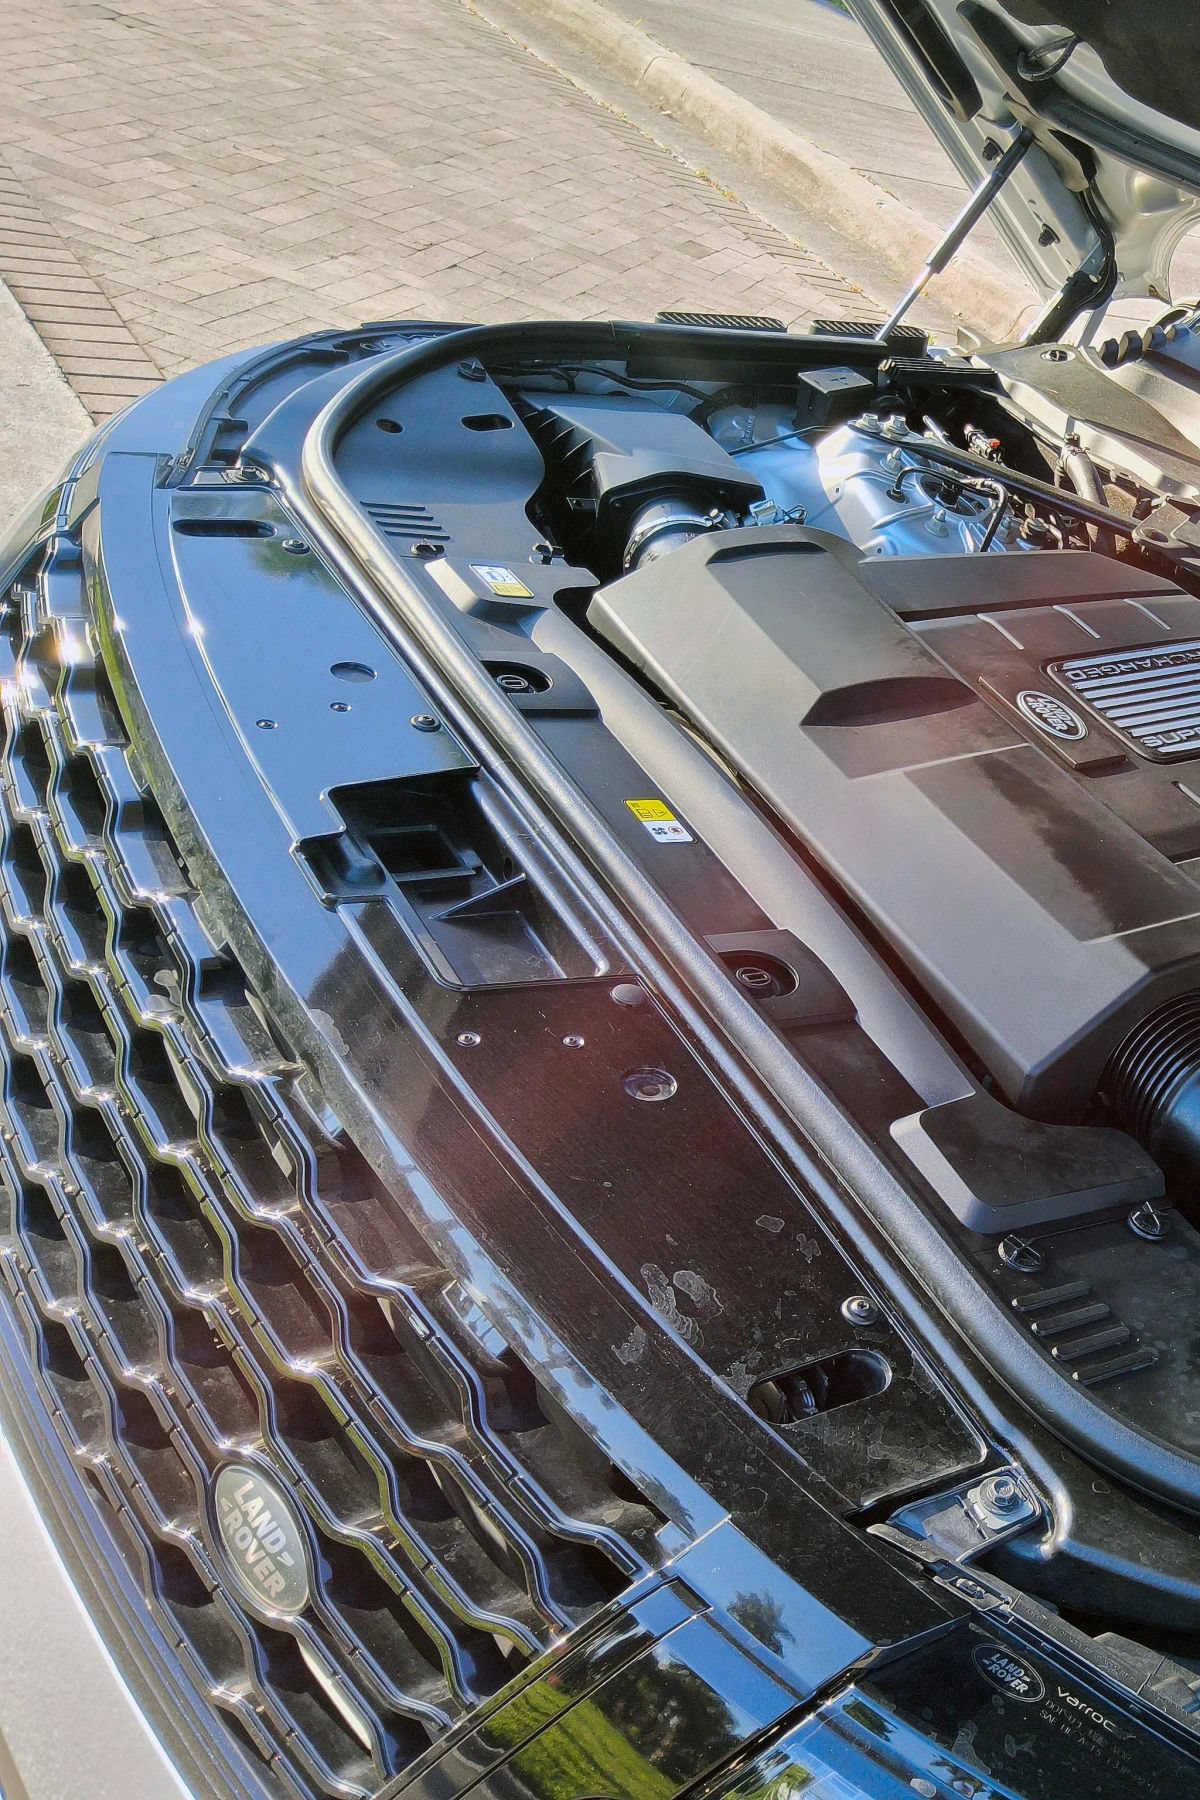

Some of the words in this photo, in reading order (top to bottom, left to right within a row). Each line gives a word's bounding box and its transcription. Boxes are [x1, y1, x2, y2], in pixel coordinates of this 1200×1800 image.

[1028, 700, 1068, 731] ROVER
[1037, 697, 1072, 723] LAND
[233, 1480, 287, 1554] LAND
[222, 1508, 286, 1598] ROVER
[988, 1664, 1029, 1694] ROVER
[991, 1653, 1025, 1678] LAND
[1057, 1686, 1118, 1733] varroc
